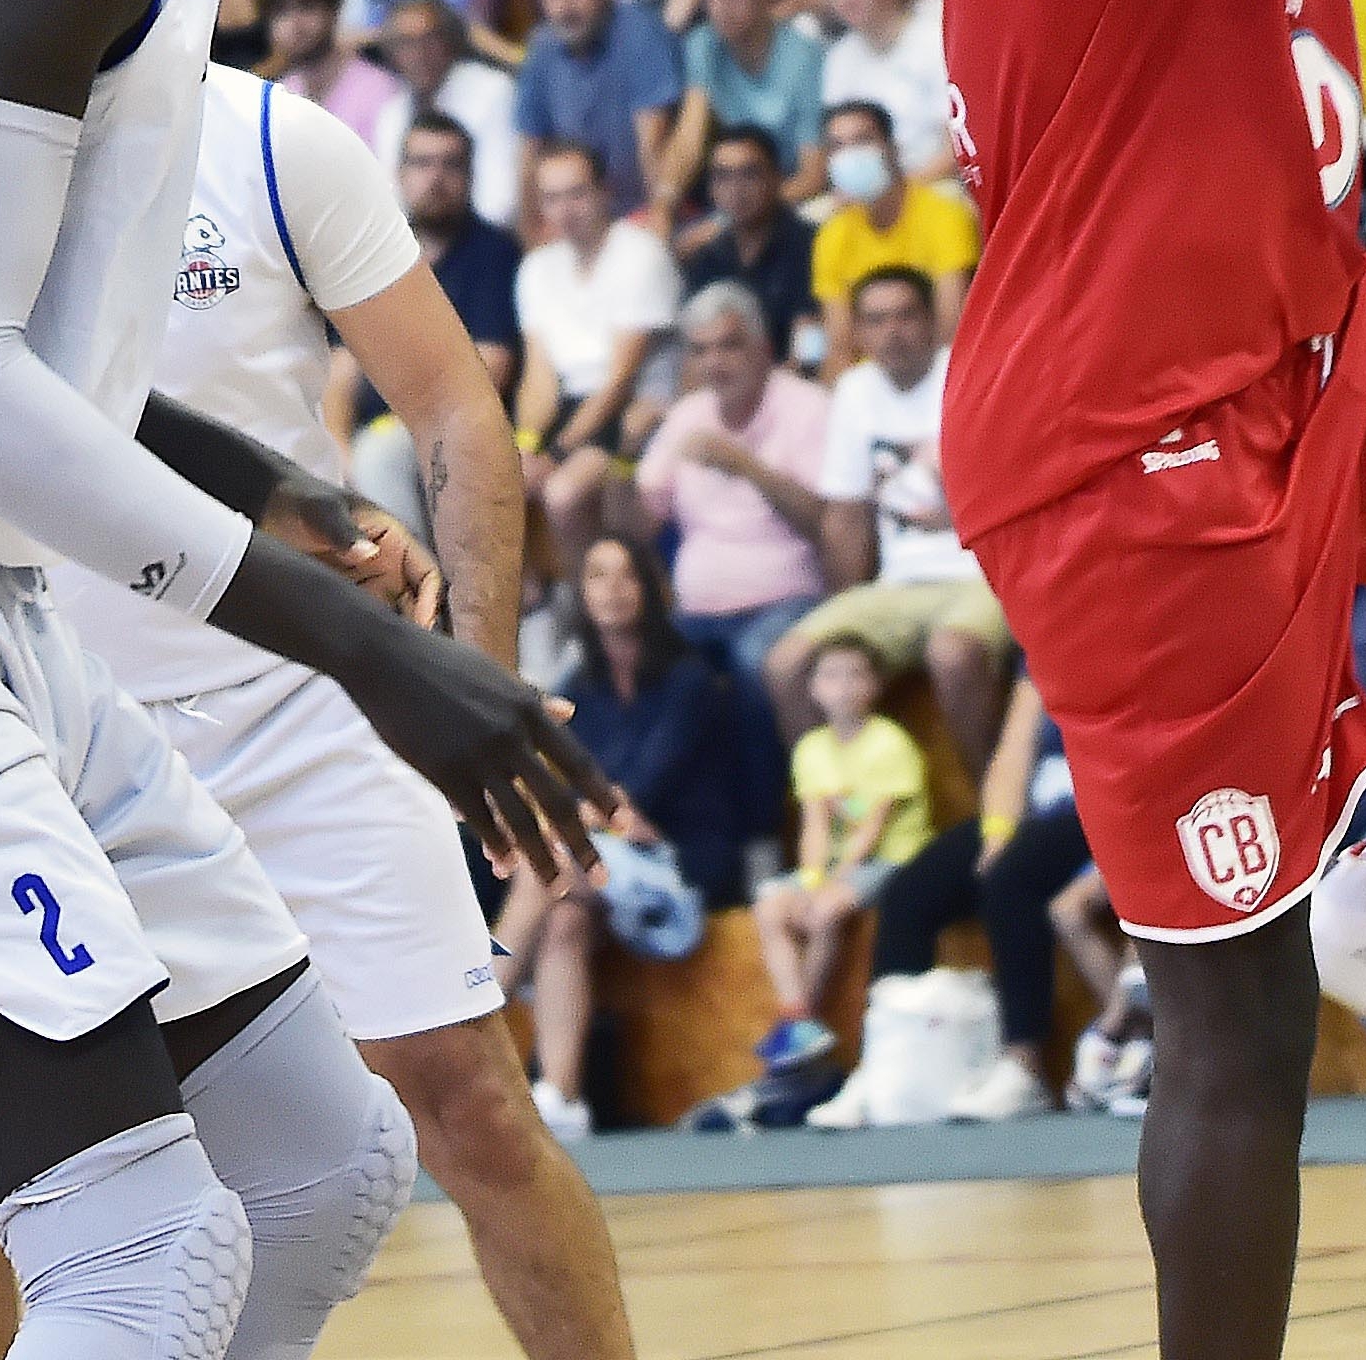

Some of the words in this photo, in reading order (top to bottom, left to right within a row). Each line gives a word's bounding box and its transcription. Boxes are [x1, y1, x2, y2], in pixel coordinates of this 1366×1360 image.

[177, 269, 237, 292] ANTES
[1198, 812, 1269, 885] CB
[11, 873, 95, 975] 2
